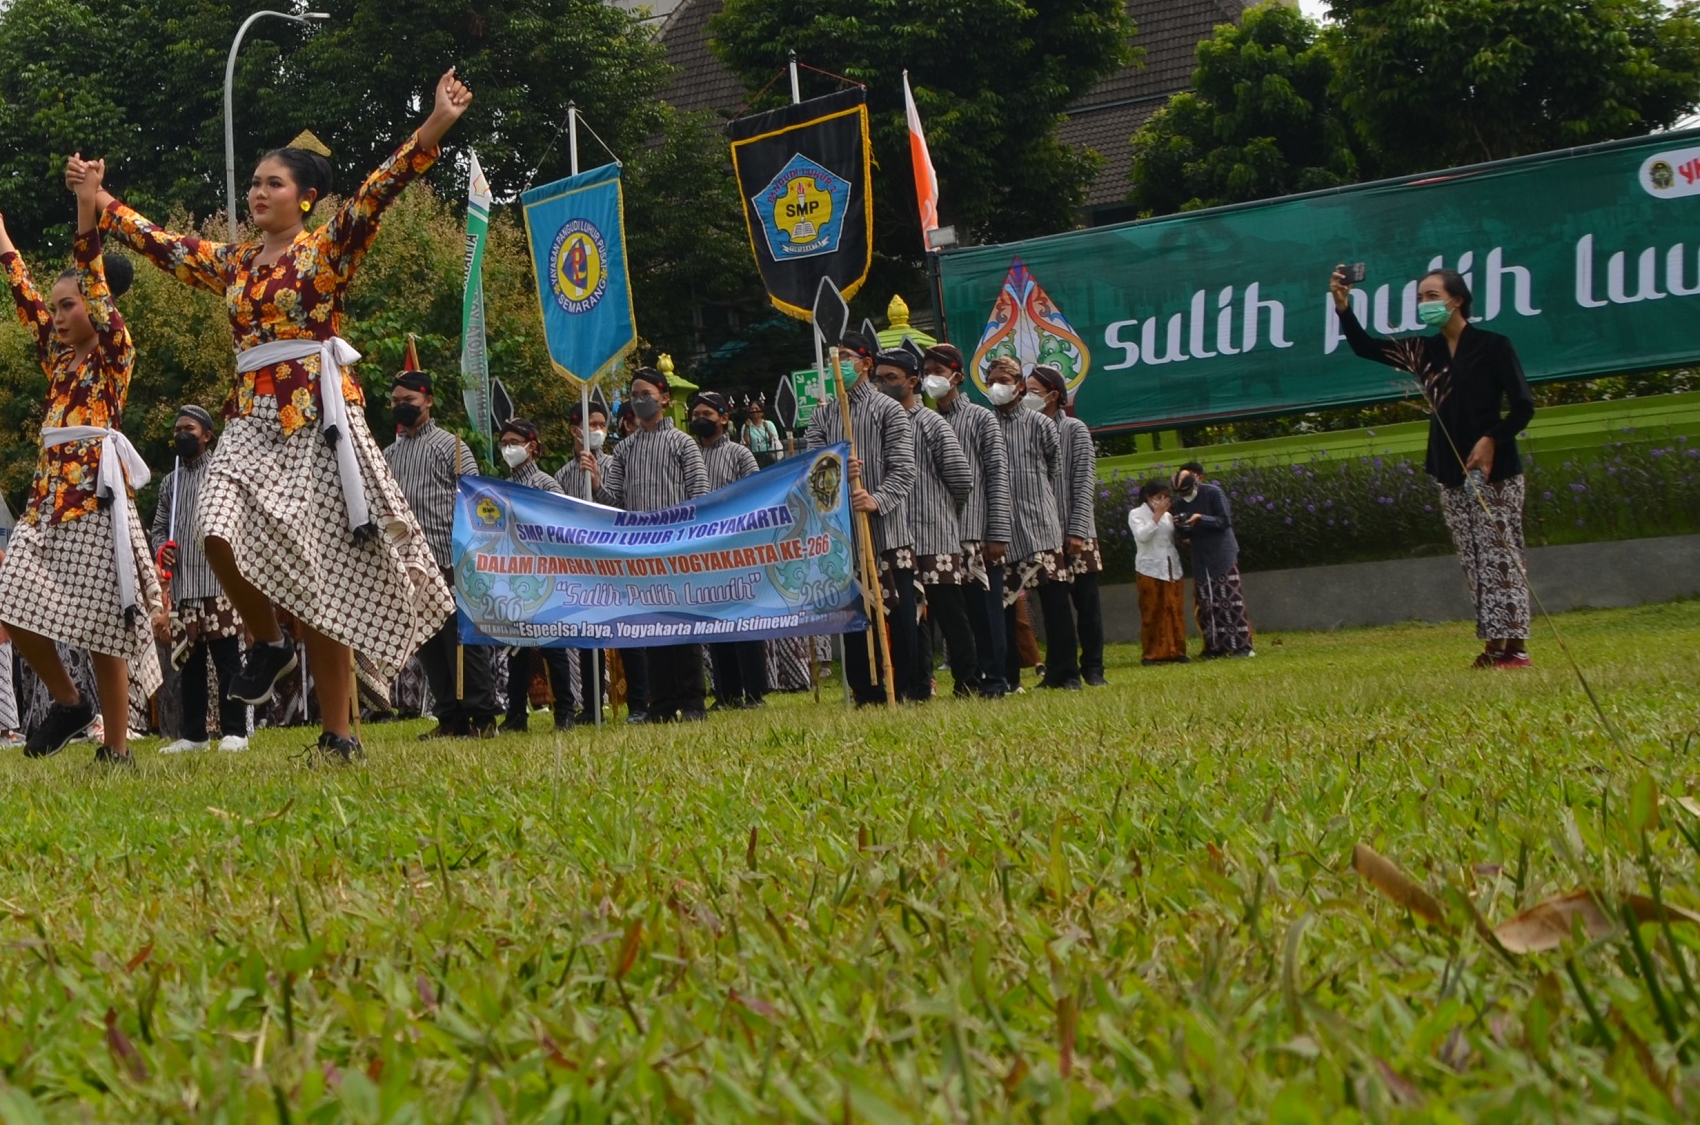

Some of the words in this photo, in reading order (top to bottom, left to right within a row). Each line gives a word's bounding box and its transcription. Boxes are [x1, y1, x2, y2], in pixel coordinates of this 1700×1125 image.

[767, 169, 799, 204] PANGUDI
[802, 168, 832, 186] LUHUR
[786, 200, 819, 217] SMP
[550, 243, 560, 285] YAYASAN
[556, 220, 580, 244] PANGUDI
[580, 220, 600, 242] LUHUR
[596, 239, 607, 268] PUSAT
[558, 278, 606, 313] SEMARANG
[1103, 281, 1294, 371] sulih
[516, 524, 544, 542] SMP
[548, 526, 615, 545] PANGUDI
[618, 529, 674, 546] LUHUR
[676, 528, 686, 542] 1
[687, 505, 793, 540] YOGYAKARTA
[614, 505, 695, 526] KARNAVAL
[476, 553, 534, 574] DALAM
[537, 556, 594, 575] RANGKA
[598, 558, 625, 576] HUT
[626, 556, 666, 576] KOTA
[667, 542, 777, 574] YOGYAKARTA
[780, 532, 831, 560] KE-266
[481, 596, 523, 622] 266
[626, 582, 679, 606] Pulih
[800, 579, 840, 610] 266
[580, 621, 614, 638] Jaya,
[616, 621, 691, 639] Yogyakarta
[693, 619, 734, 635] Makin
